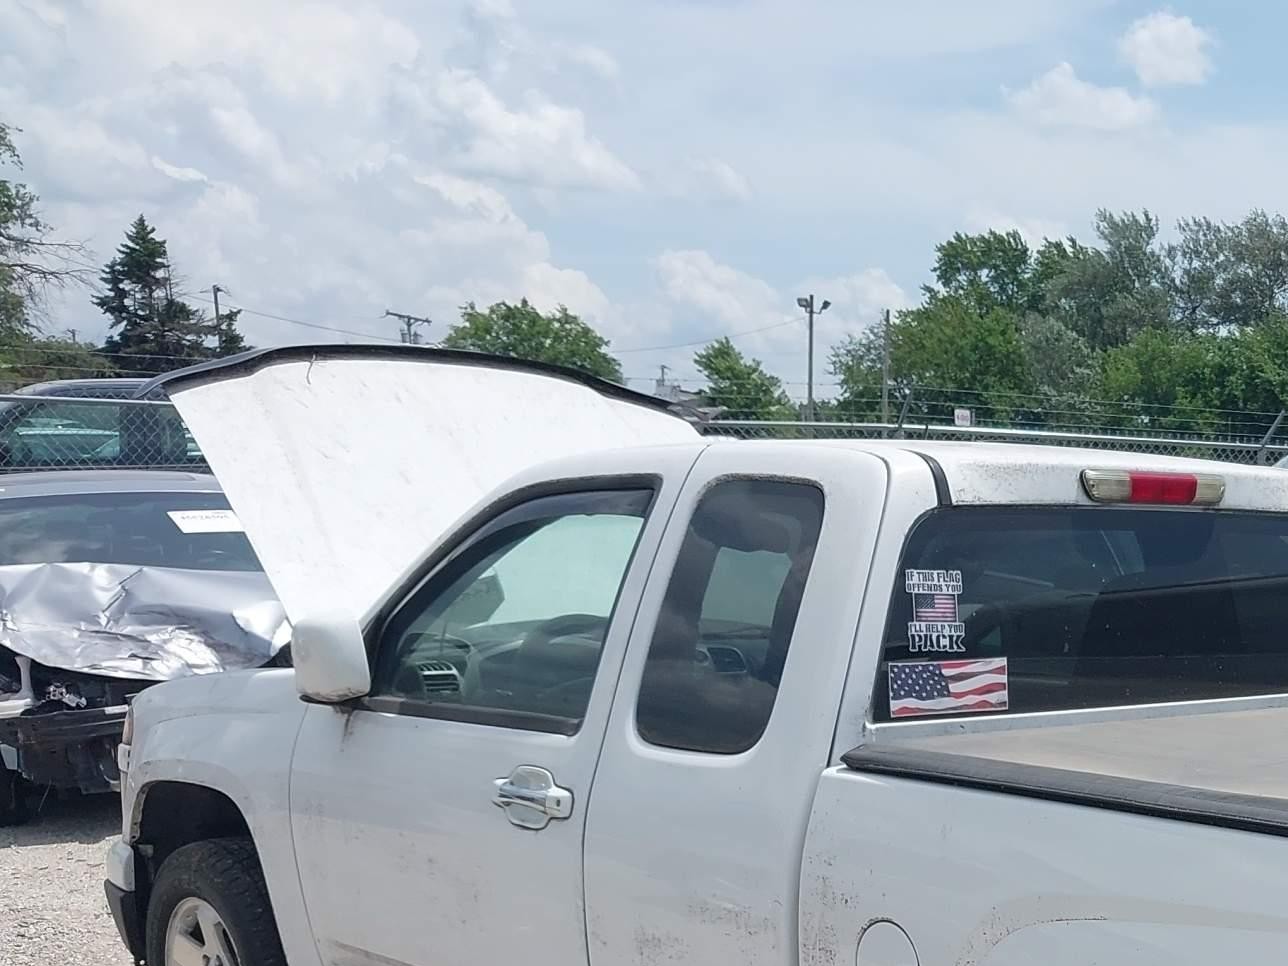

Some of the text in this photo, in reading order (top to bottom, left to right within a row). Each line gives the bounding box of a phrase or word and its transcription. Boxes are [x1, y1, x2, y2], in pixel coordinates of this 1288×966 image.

[906, 571, 961, 584] IF THIS FLAG
[906, 583, 962, 593] OFFENDS YOU
[909, 623, 964, 634] I'LL HELP YOU
[909, 634, 965, 650] PACK
